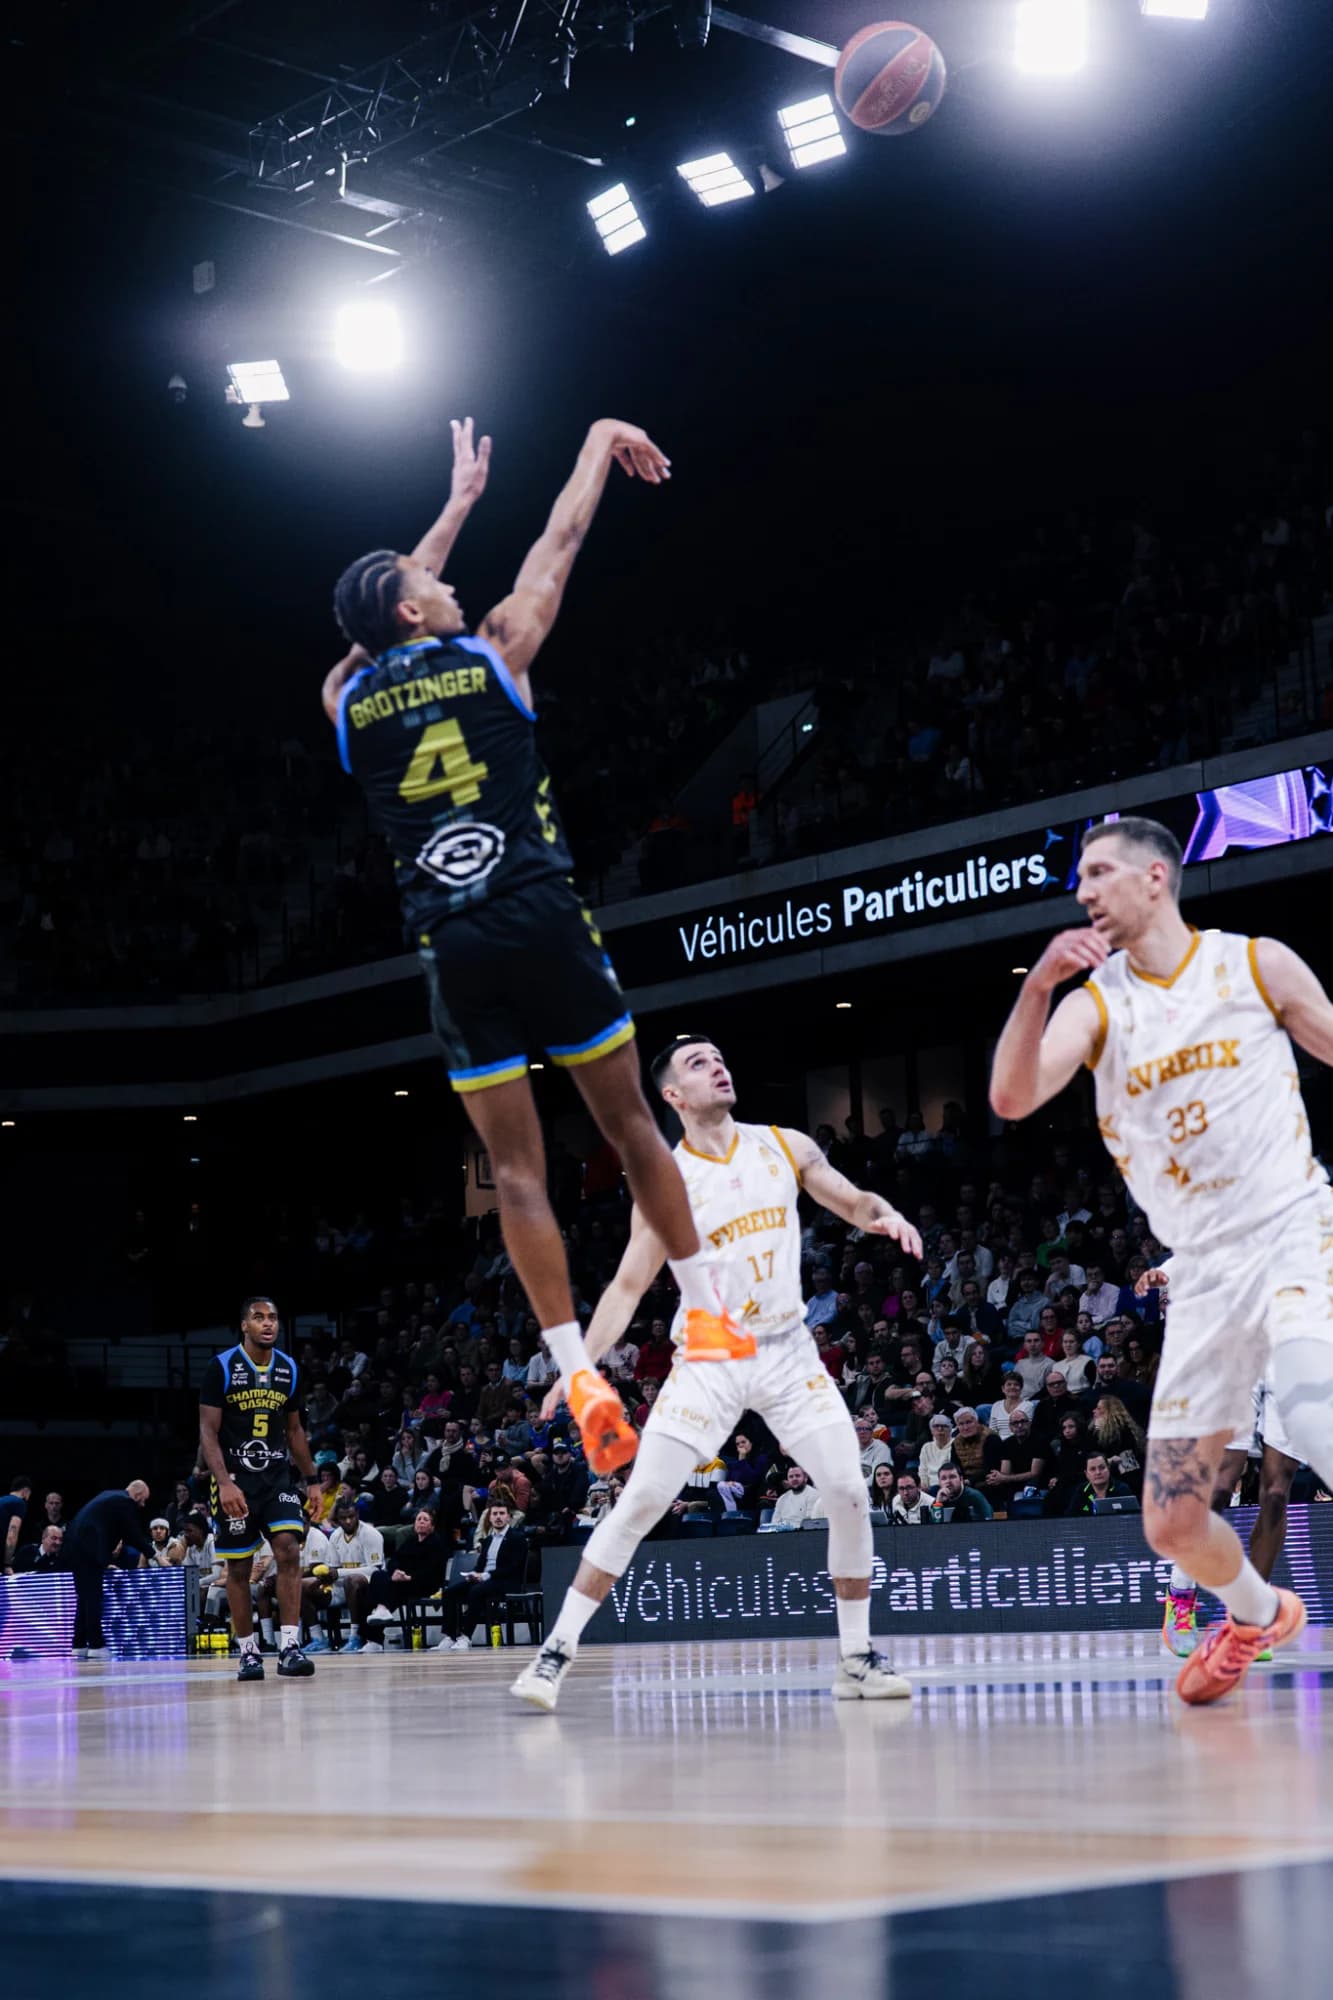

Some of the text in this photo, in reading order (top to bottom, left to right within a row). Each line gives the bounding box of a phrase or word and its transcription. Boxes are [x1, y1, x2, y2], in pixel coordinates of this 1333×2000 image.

[398, 718, 488, 807] 4
[679, 854, 1047, 962] Véhicules Particuliers
[1167, 1100, 1209, 1145] 33
[747, 1250, 775, 1283] 17
[225, 1388, 288, 1405] CHAMPAGN
[238, 1399, 281, 1411] BASKET
[252, 1413, 269, 1437] 5
